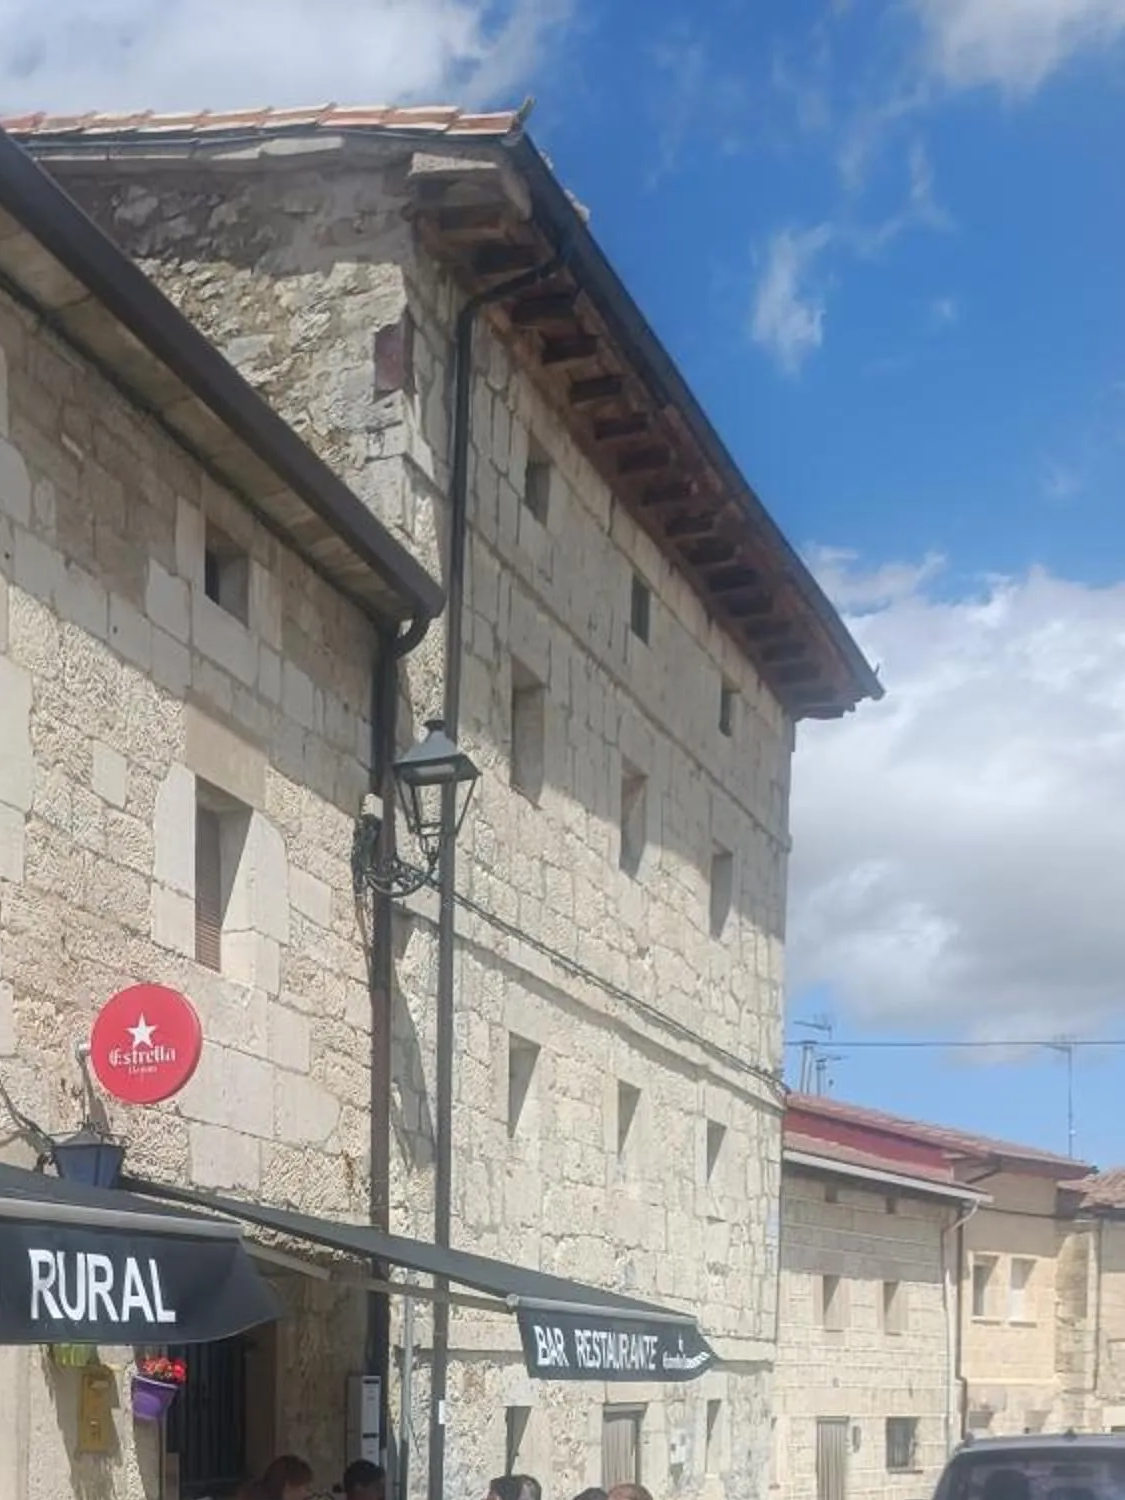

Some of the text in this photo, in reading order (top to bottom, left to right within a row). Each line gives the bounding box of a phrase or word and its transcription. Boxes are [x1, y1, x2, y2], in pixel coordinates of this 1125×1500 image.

[108, 1045, 176, 1067] Estrella
[28, 1248, 176, 1324] RURAL
[533, 1324, 570, 1367] BAR
[574, 1328, 658, 1371] RESTAURANTE
